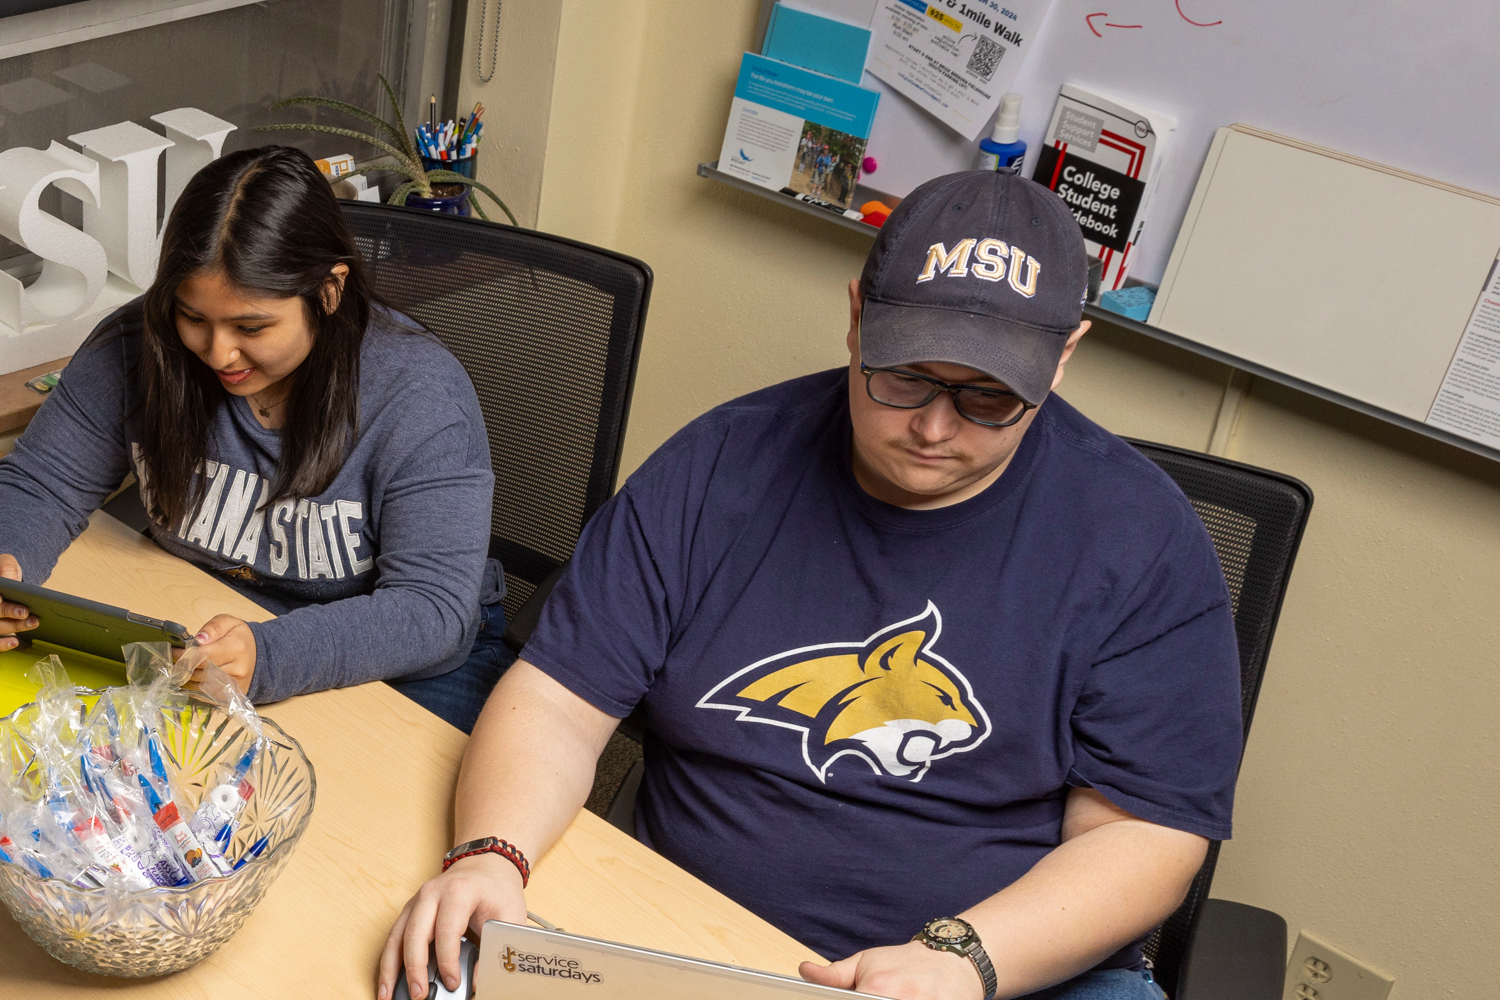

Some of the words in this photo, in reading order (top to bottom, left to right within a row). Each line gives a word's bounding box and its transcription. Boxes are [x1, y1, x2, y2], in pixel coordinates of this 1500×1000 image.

[928, 8, 944, 21] $25
[988, 1, 1001, 12] 30,
[1000, 7, 1018, 21] 2024
[957, 2, 993, 28] 1mile
[991, 22, 1024, 46] Walk
[908, 44, 921, 53] START
[938, 63, 951, 73] BRICK
[949, 71, 969, 84] BREEDEN
[966, 82, 991, 99] FIELDHOUSE
[927, 62, 942, 73] (SOUTH
[940, 71, 959, 84] PARKING
[957, 82, 968, 90] LOT)
[1061, 120, 1095, 138] Support
[1064, 111, 1097, 128] Student
[1058, 129, 1093, 147] Services
[1059, 165, 1123, 202] College
[1055, 183, 1120, 217] Student
[916, 237, 1041, 299] MSU
[268, 498, 376, 580] STATE
[517, 951, 579, 969] service
[517, 962, 601, 984] saturdays
